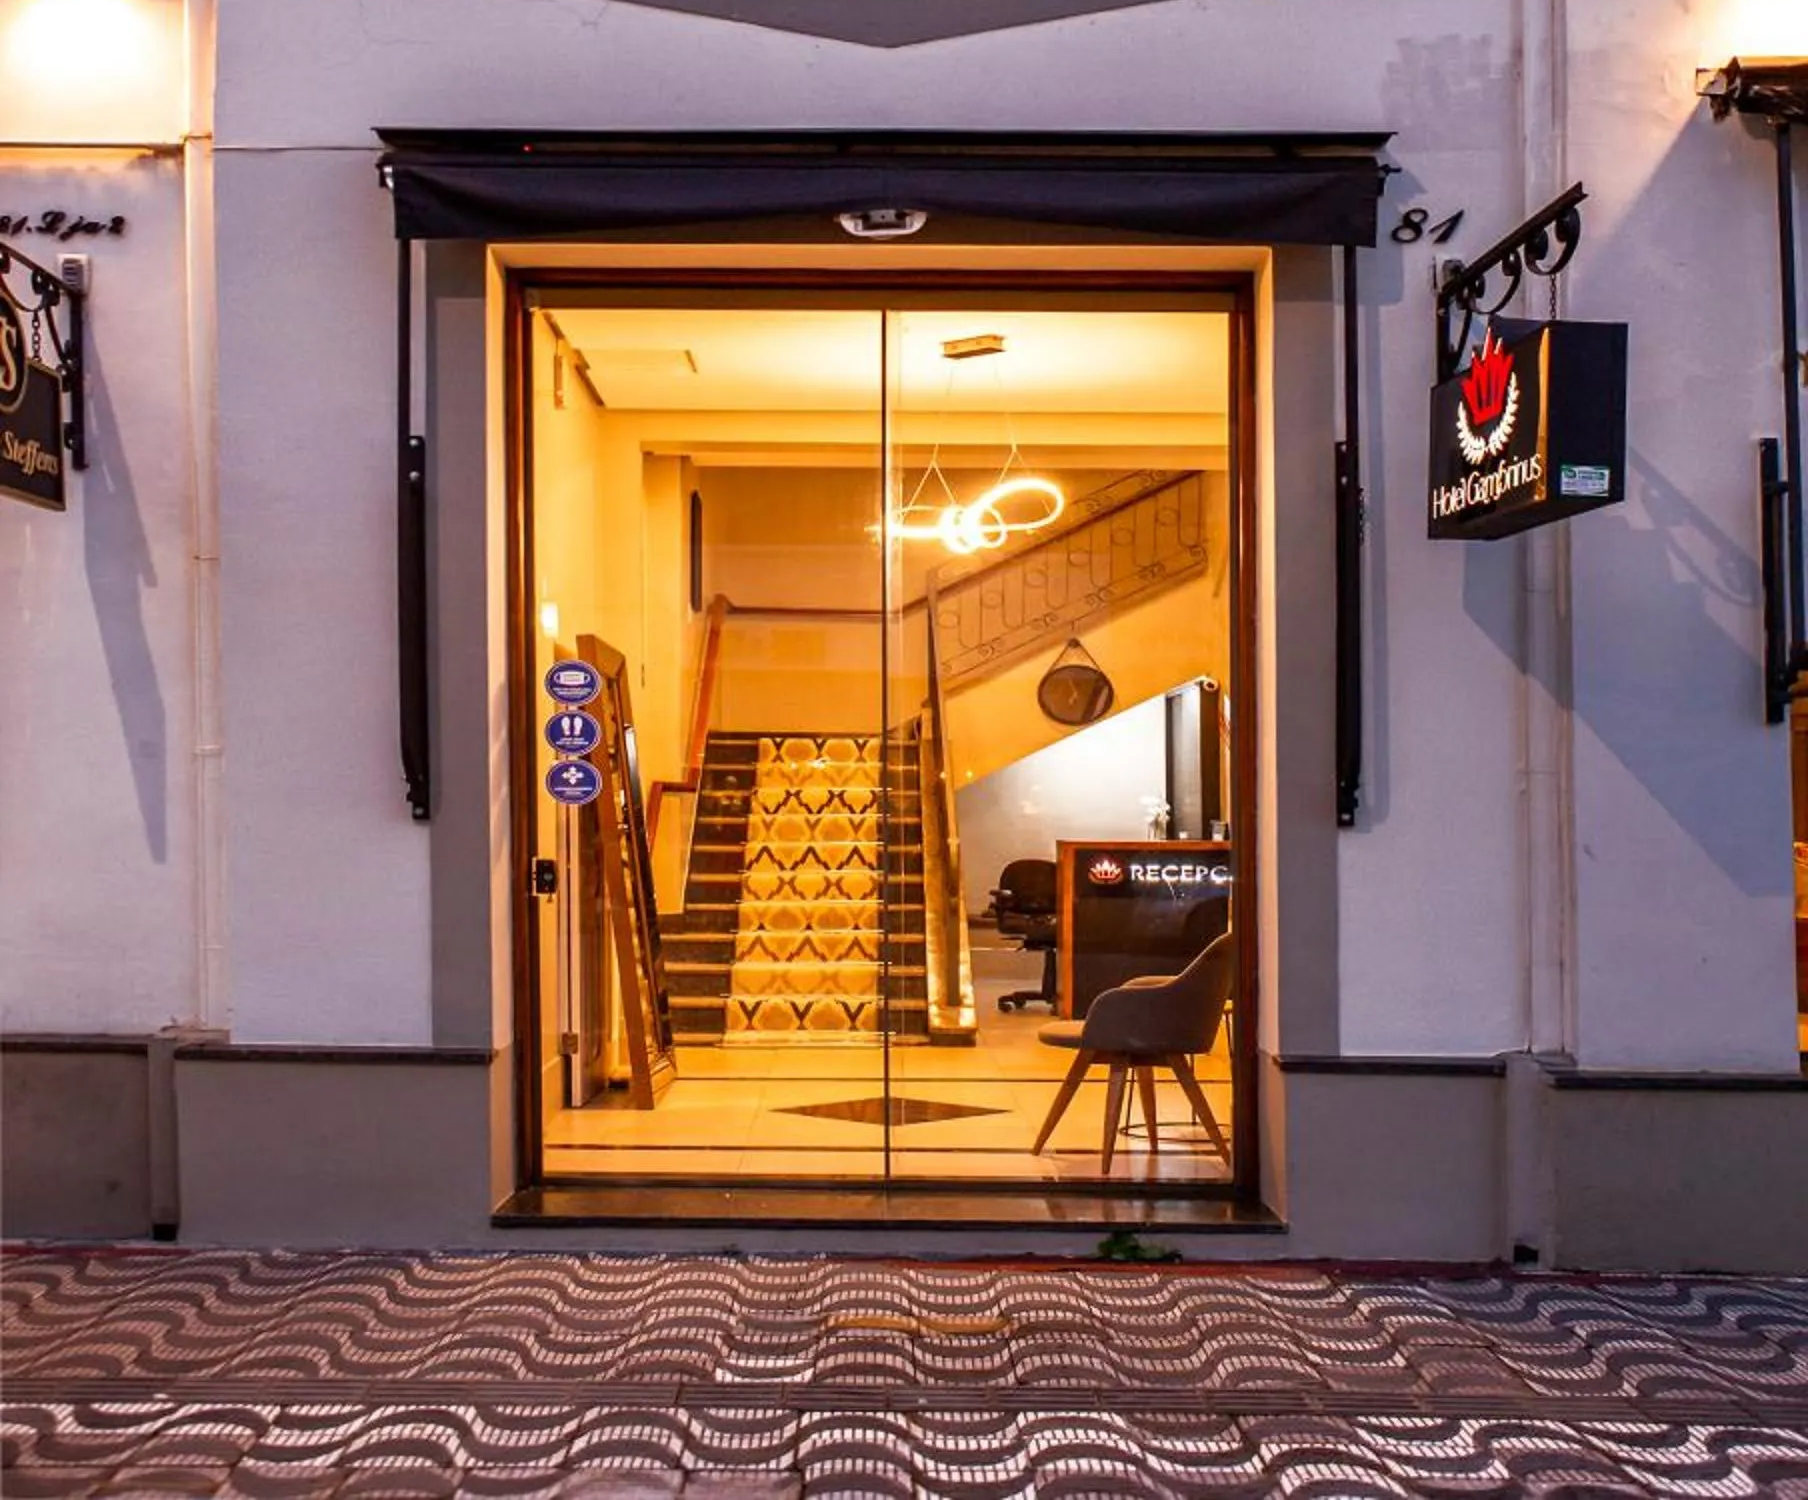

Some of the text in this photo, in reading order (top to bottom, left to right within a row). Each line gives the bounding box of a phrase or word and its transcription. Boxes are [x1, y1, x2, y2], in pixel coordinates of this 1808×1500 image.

[1392, 208, 1464, 244] 81
[1433, 477, 1466, 519] Hotel
[1467, 453, 1542, 505] Gambrinus
[1130, 864, 1233, 884] RECEPÇ
